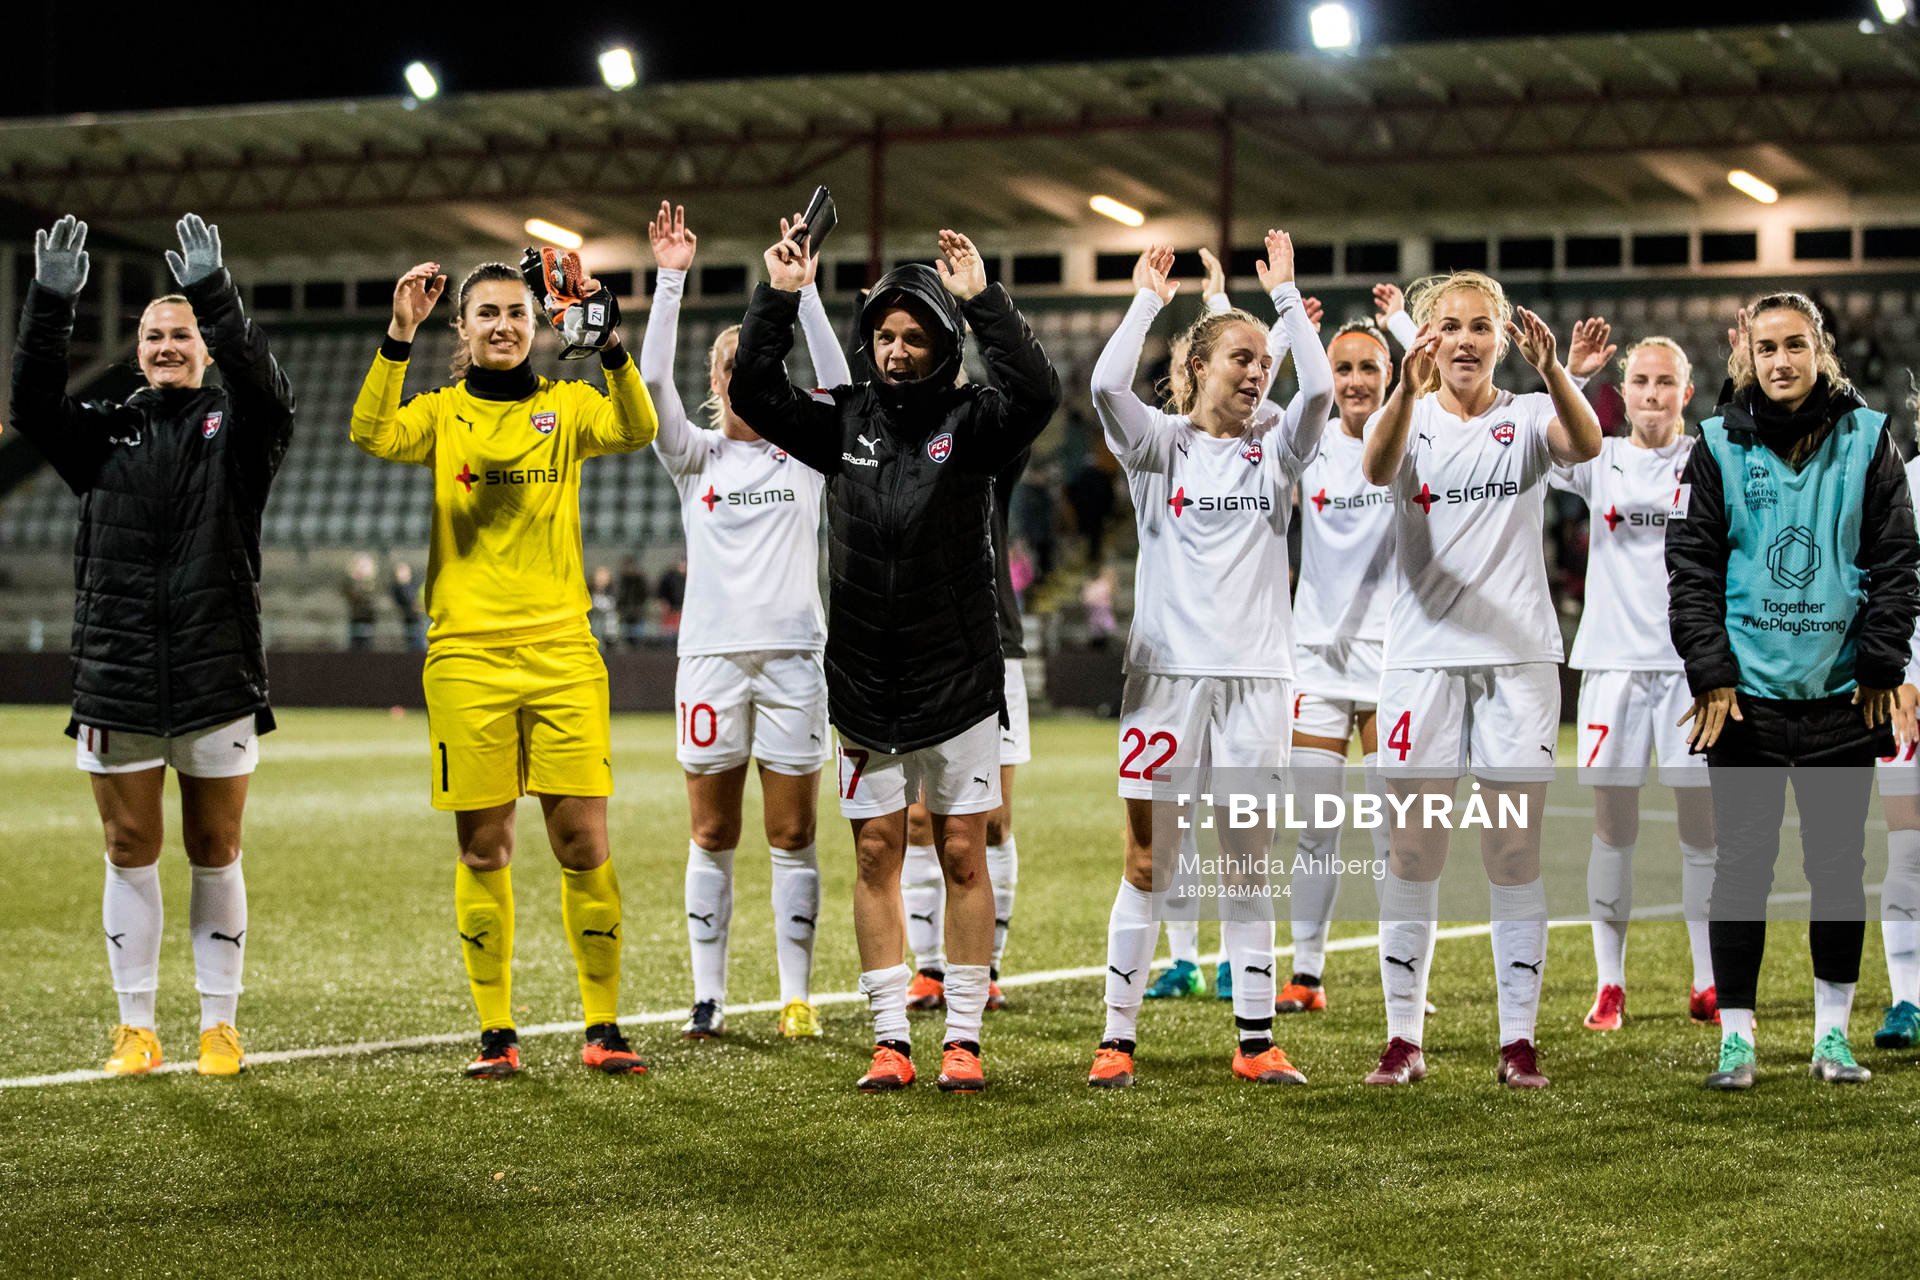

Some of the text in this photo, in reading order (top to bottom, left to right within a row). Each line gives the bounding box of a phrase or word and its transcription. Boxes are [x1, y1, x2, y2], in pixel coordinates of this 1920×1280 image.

[931, 440, 949, 452] FCR
[1495, 426, 1514, 436] FCR
[1630, 513, 1665, 526] SIG
[1761, 598, 1825, 617] Together
[1742, 615, 1846, 636] #WePlayStrong
[681, 702, 717, 747] 10
[1387, 710, 1411, 761] 4
[1119, 727, 1178, 783] 22
[1587, 724, 1609, 768] 7
[438, 742, 448, 792] 1
